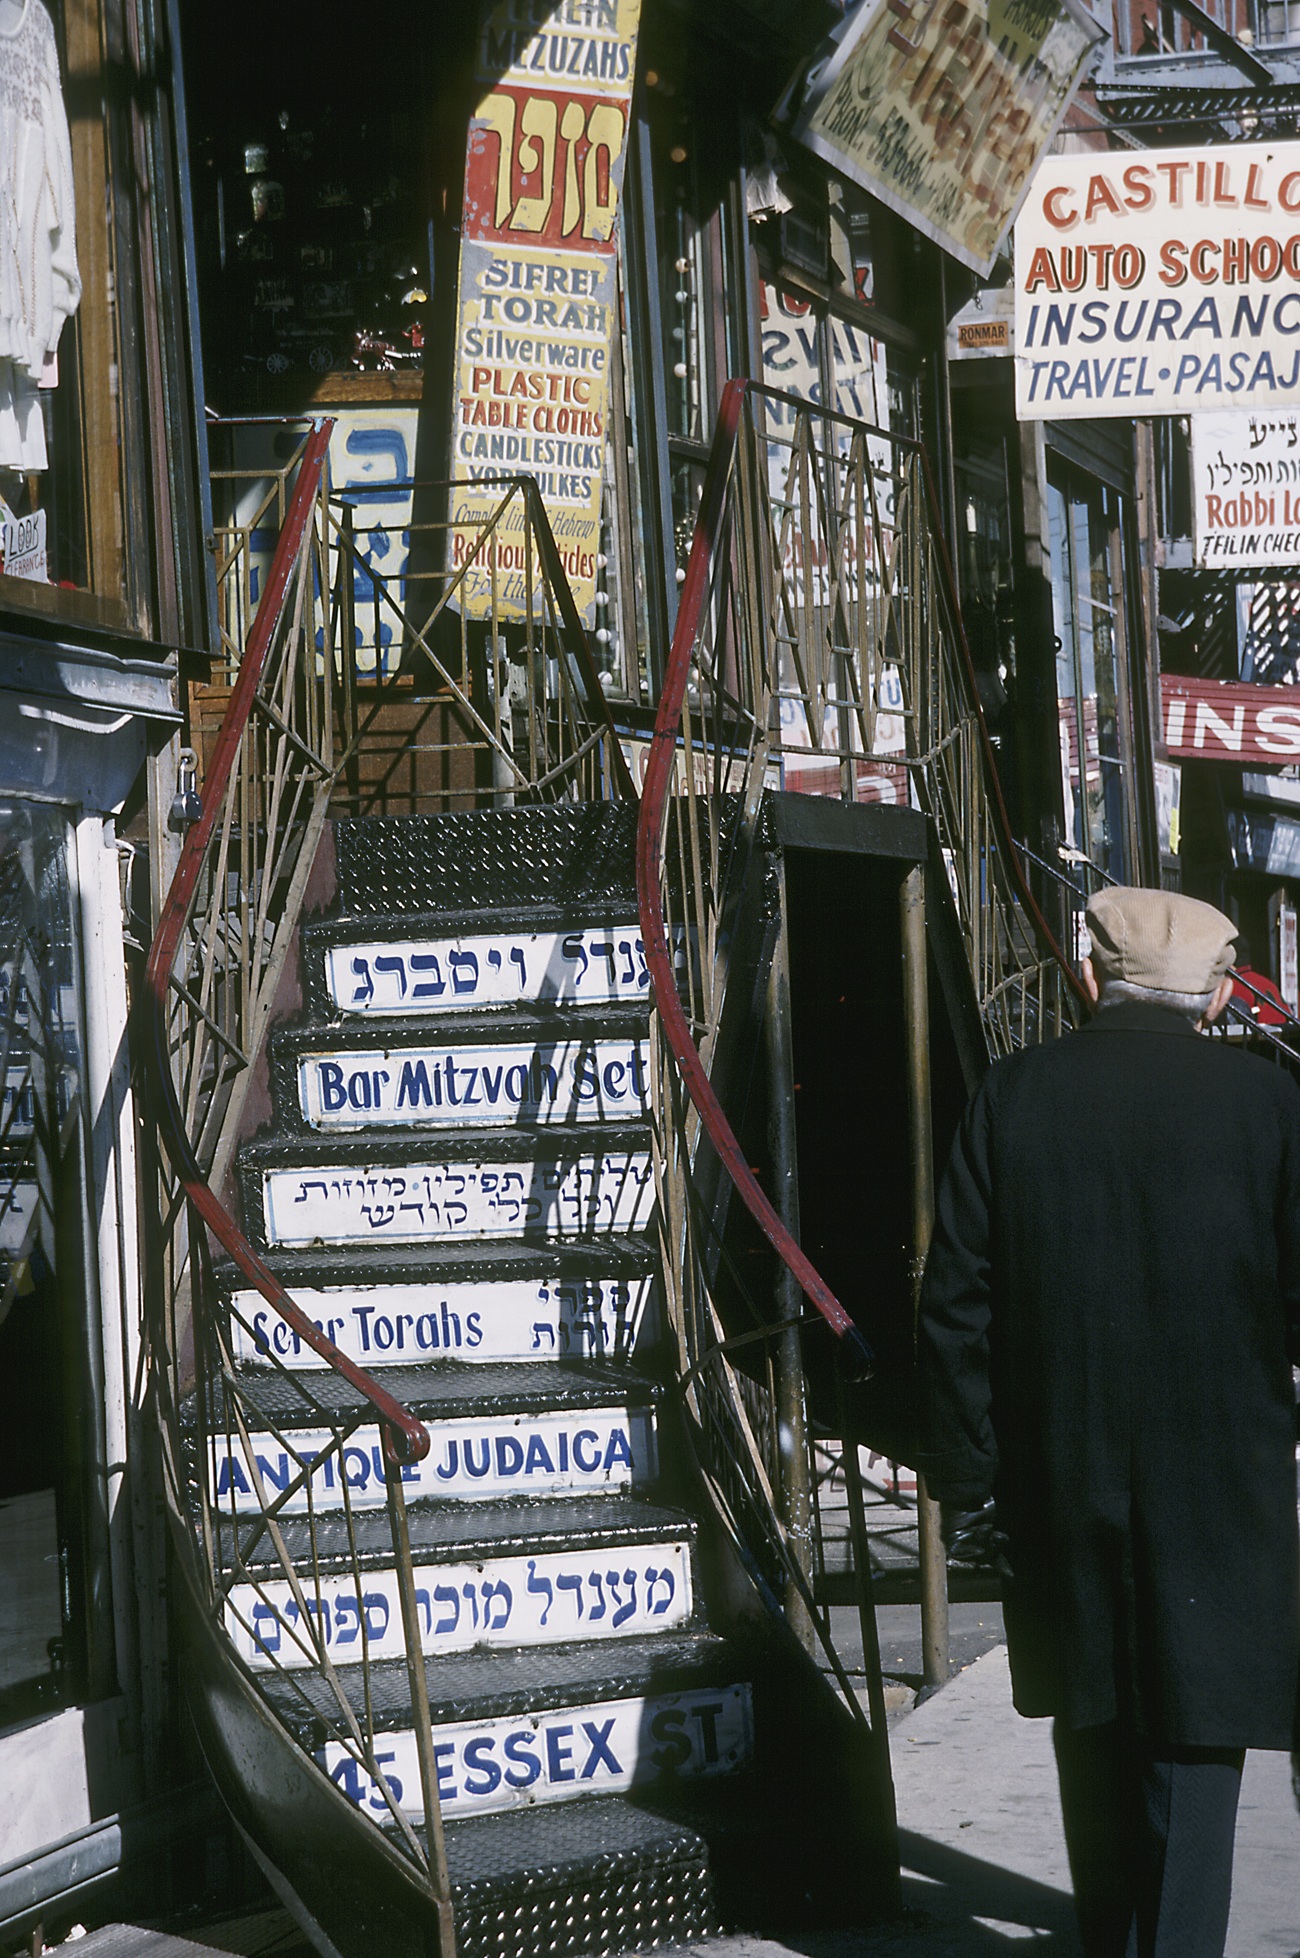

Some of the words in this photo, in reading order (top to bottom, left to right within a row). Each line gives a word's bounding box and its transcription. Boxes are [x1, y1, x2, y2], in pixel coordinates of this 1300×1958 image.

[1043, 161, 1300, 231] CASTILLO
[1025, 243, 1145, 292] AUTO
[480, 293, 605, 335] TORAH
[960, 325, 1005, 341] RONMAR
[1025, 293, 1300, 348] INSURANC
[463, 329, 605, 372] Silverware
[472, 367, 591, 404] PLASTIC
[460, 397, 527, 430] TABLE
[533, 406, 603, 438] CLOTHS
[460, 431, 602, 471] CANDLESTICKS
[1206, 450, 1273, 491] ותפילין
[1205, 491, 1275, 528] Rabbi
[9, 515, 39, 557] LOOK
[1166, 700, 1300, 755] INS
[318, 1062, 390, 1111] Bar
[397, 1053, 558, 1109] Mitzvah
[421, 1166, 526, 1199] תפילין
[360, 1199, 468, 1231] קודש
[351, 1302, 485, 1353] Torahs
[436, 1428, 634, 1480] JUDAICA
[329, 1750, 405, 1811] 45
[434, 1717, 625, 1802] ESSEX
